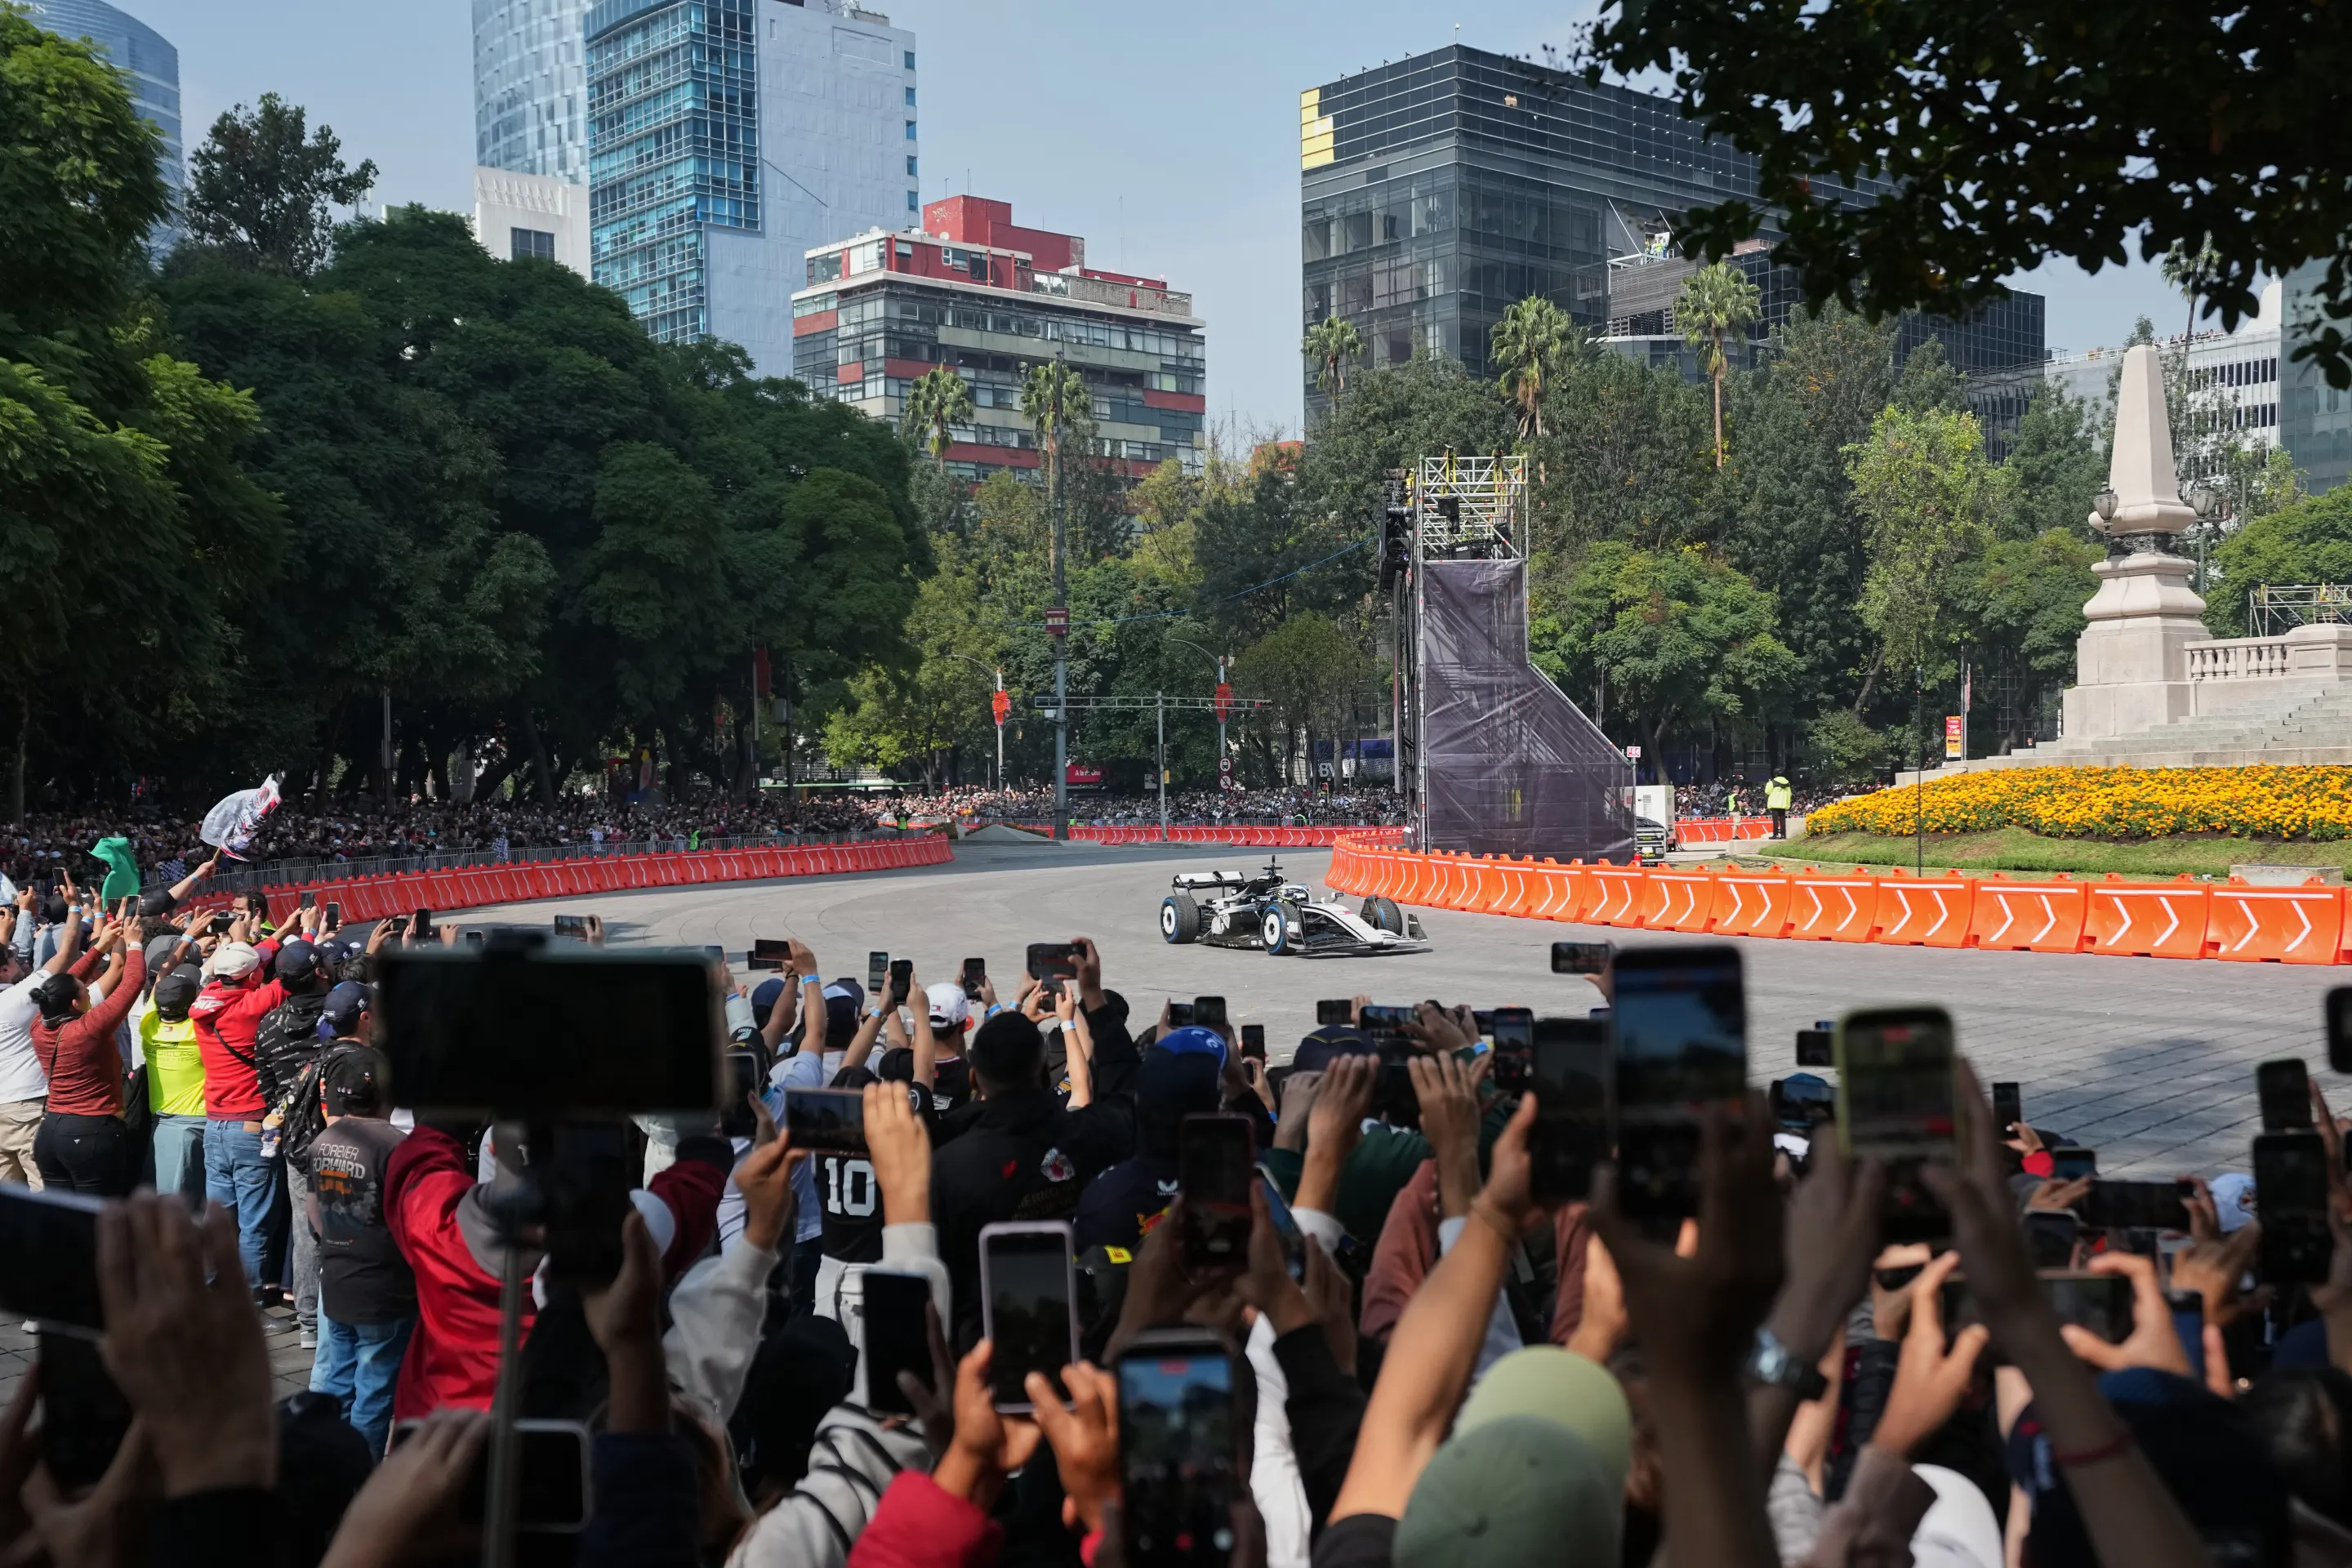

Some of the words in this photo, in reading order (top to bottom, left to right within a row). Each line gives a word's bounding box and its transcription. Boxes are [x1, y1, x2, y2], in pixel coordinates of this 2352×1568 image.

[317, 1143, 359, 1160] FOREVER
[313, 1156, 366, 1179] FORWARD
[824, 1156, 875, 1217] 10
